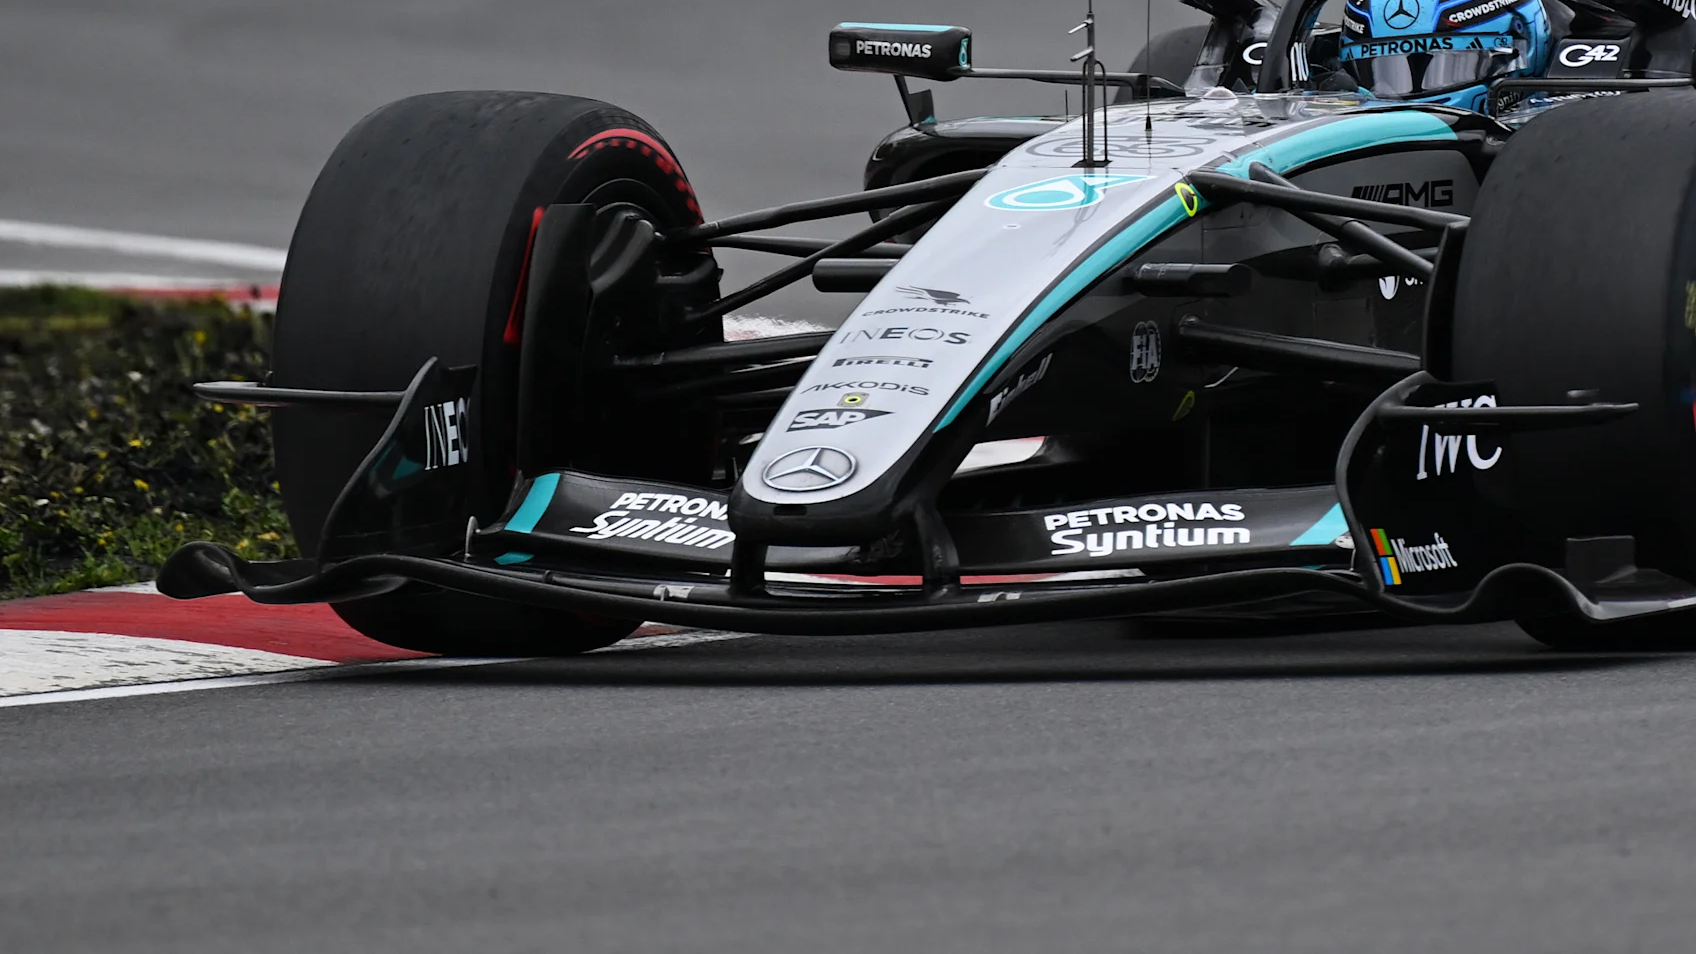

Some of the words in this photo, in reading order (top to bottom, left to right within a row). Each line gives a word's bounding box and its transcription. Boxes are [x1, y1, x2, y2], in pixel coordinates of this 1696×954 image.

[856, 39, 932, 60] PETRONAS
[1360, 37, 1454, 58] PETRONAS
[1559, 44, 1620, 69] G42
[862, 305, 991, 320] CROWDSTRIKE
[839, 326, 971, 346] INEOS
[832, 356, 934, 369] PIRELLI
[789, 410, 867, 429] SAP
[1044, 502, 1245, 532] PETRONAS
[569, 510, 737, 550] Syntium
[1050, 522, 1251, 558] Syntium
[1395, 532, 1458, 575] Microsoft
